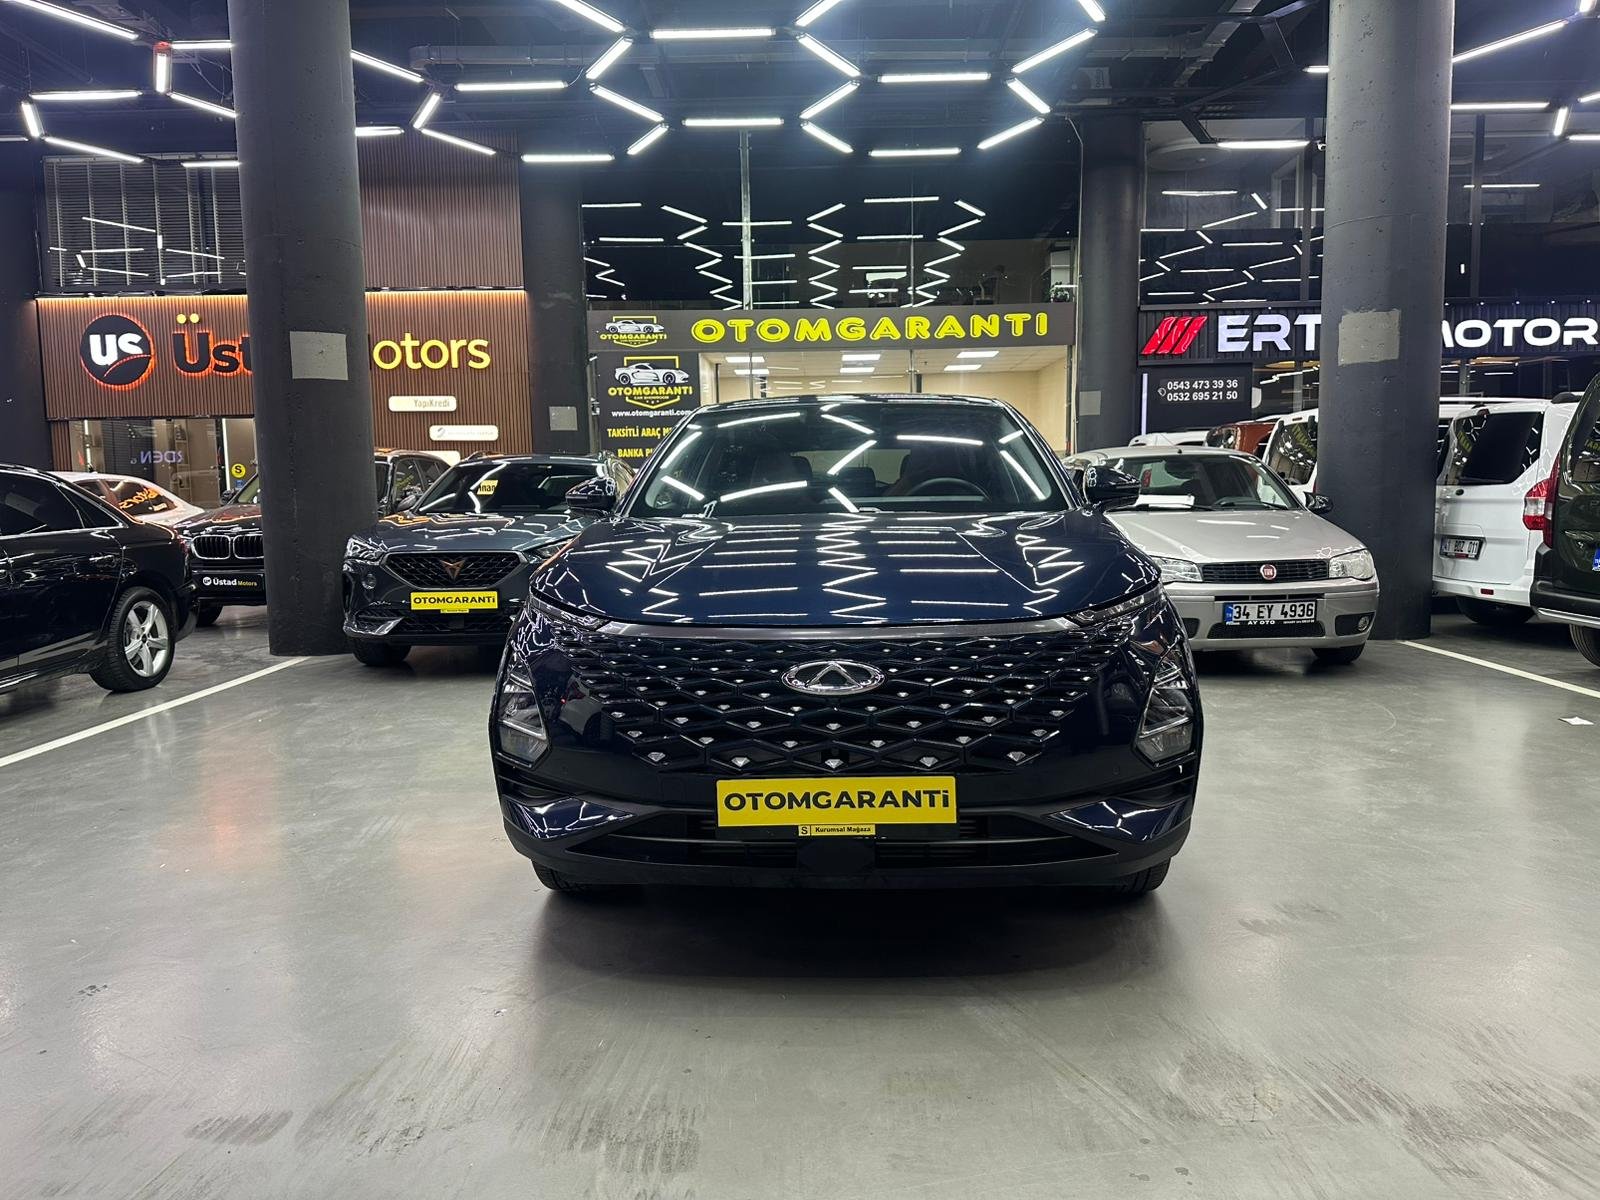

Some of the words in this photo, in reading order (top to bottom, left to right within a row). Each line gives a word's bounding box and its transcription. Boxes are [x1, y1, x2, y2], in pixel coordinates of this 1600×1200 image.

[691, 312, 1048, 343] OTOMGARANTI
[1218, 314, 1321, 352] ERT
[368, 332, 491, 370] otors
[1167, 380, 1190, 390] 0543
[1192, 380, 1210, 389] 473
[1212, 380, 1224, 389] 39
[1226, 379, 1238, 388] 36
[608, 386, 692, 396] OTOMGARANTI
[1167, 391, 1190, 401] 0532
[1192, 391, 1210, 400] 695
[1212, 391, 1223, 400] 21
[1226, 390, 1238, 399] 50
[607, 425, 639, 437] TAKSİTLİ
[641, 427, 661, 439] ARAÇ
[618, 447, 644, 457] BANKA
[213, 578, 237, 586] Üstad
[1234, 605, 1250, 620] 34
[1257, 604, 1274, 619] EY
[1281, 603, 1314, 618] 4936
[801, 826, 808, 835] S
[846, 826, 871, 834] Mağaza
